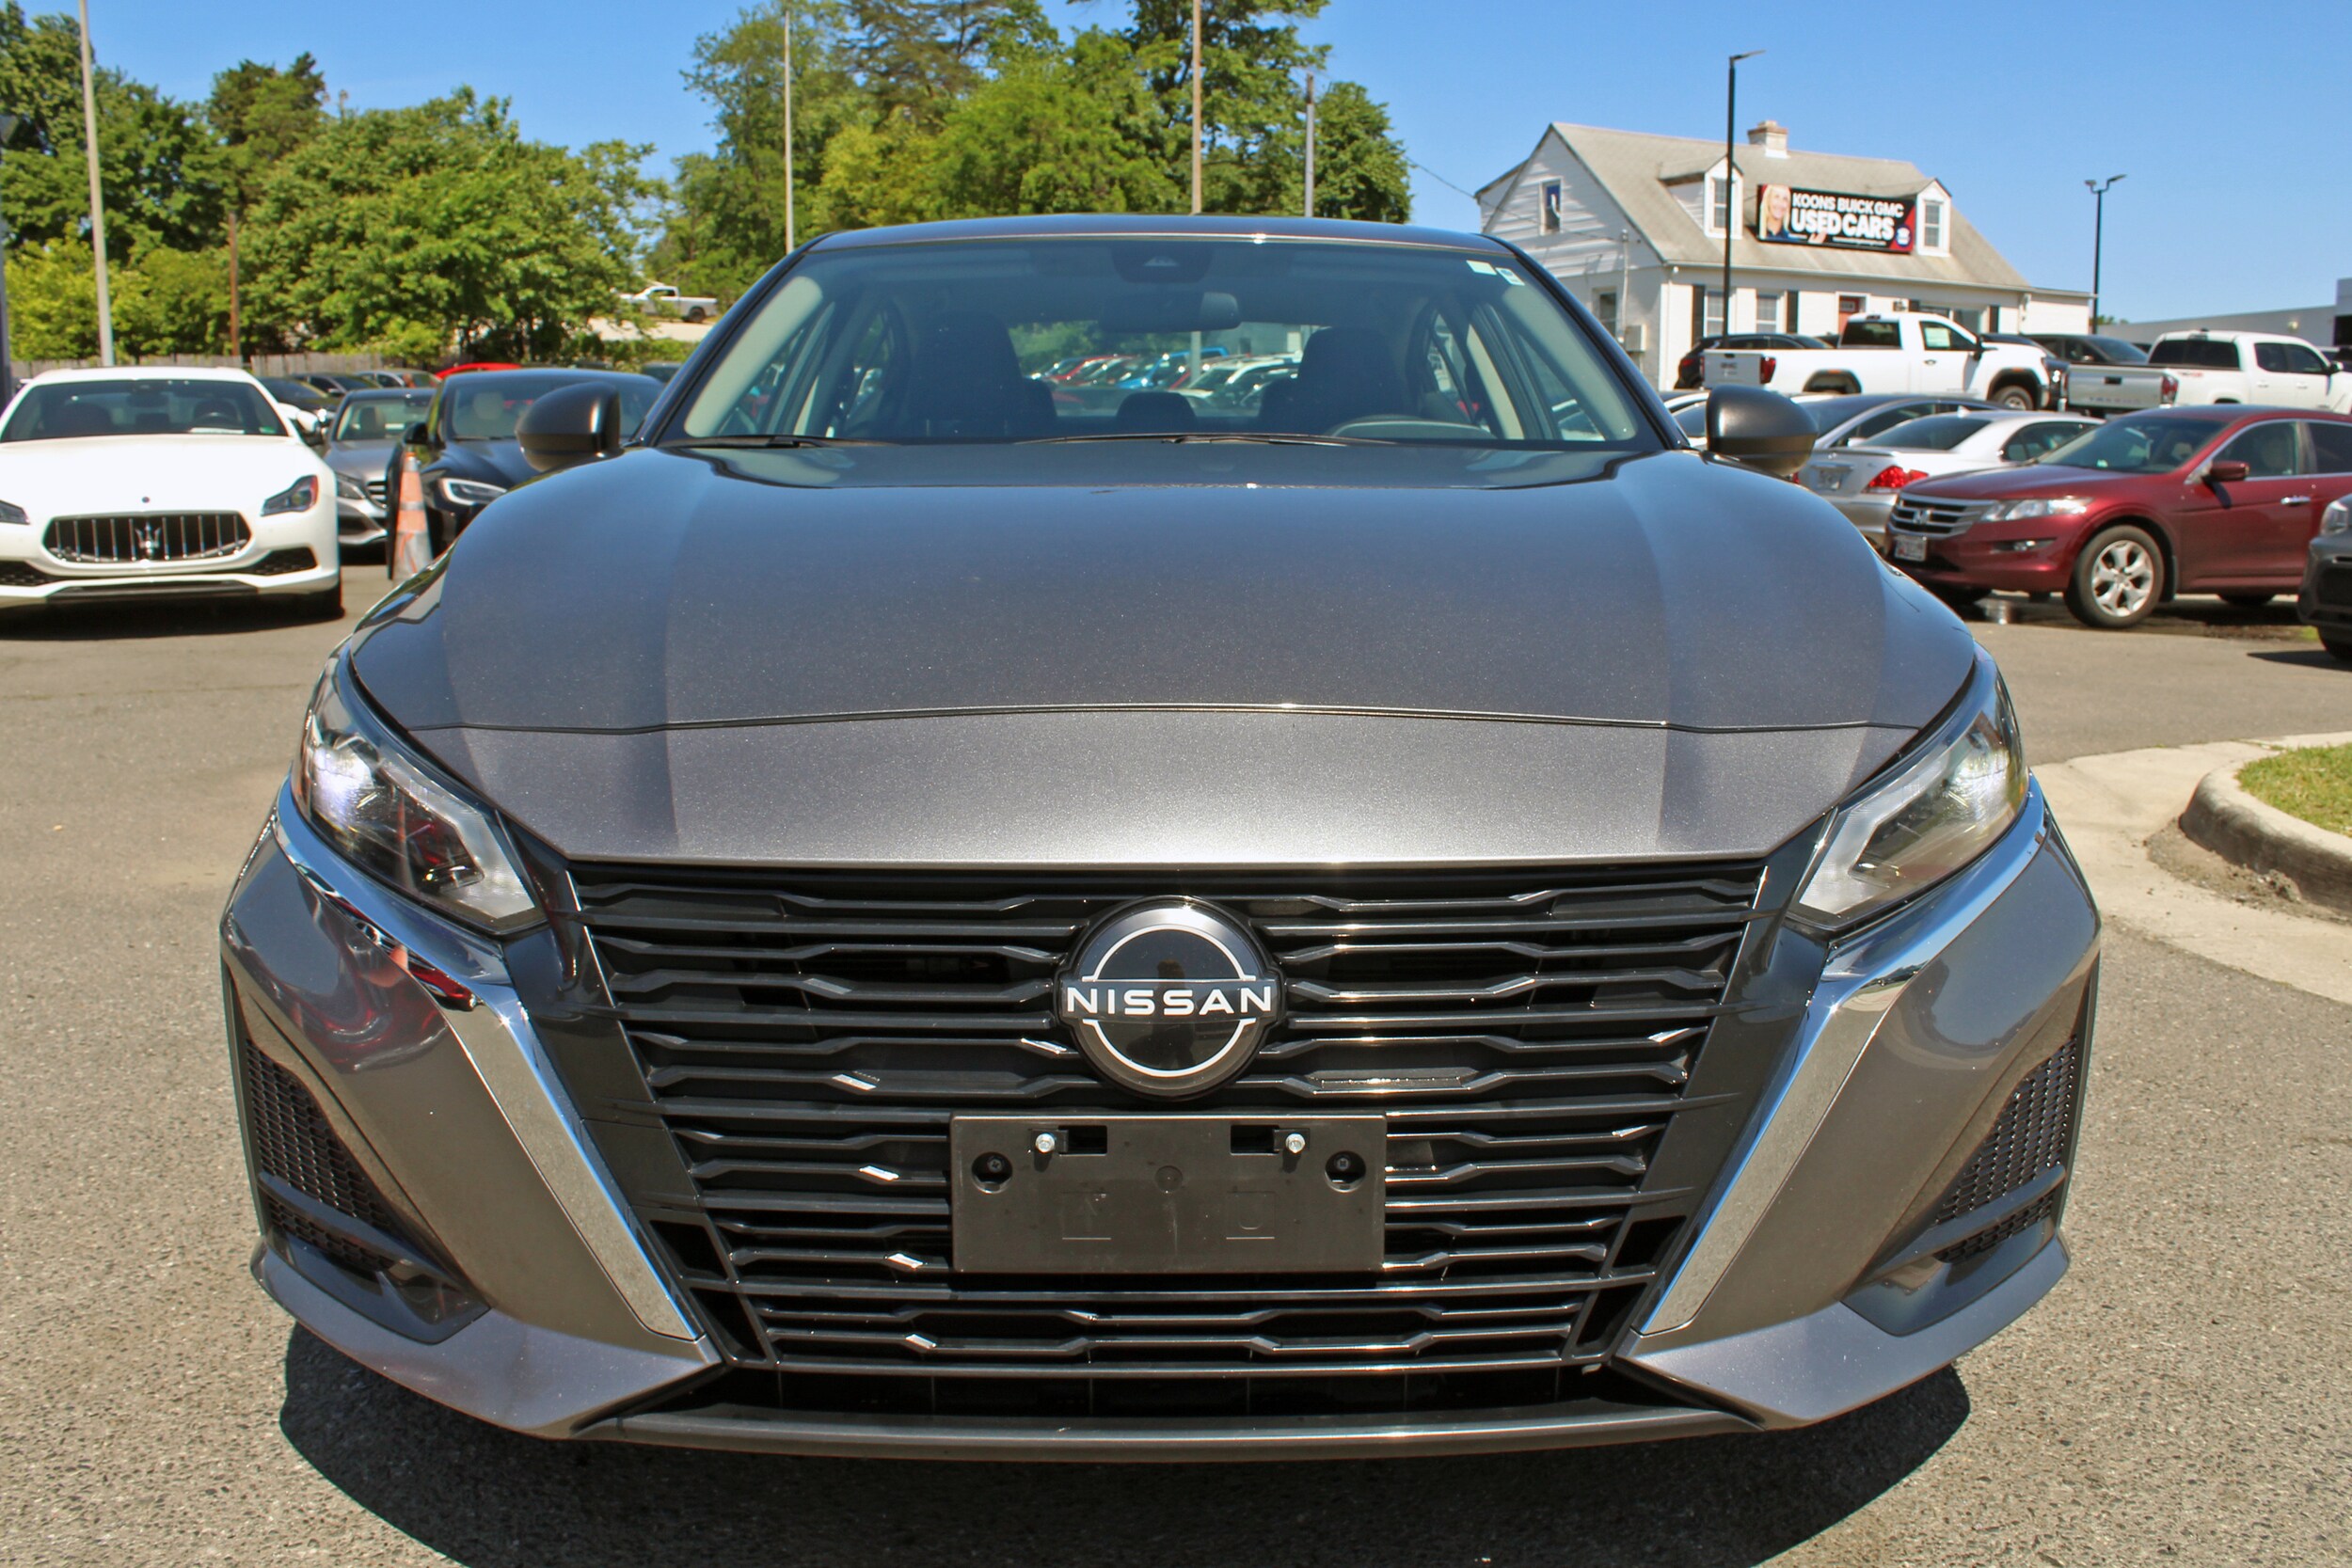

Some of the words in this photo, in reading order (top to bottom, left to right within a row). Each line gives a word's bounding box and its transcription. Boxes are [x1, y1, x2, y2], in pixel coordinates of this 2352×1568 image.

[1792, 193, 1836, 212] KOONS
[1837, 198, 1874, 214] BUICK
[1874, 201, 1904, 218] GMC
[1791, 208, 1842, 235] USED
[1842, 214, 1895, 241] CARS
[1067, 986, 1271, 1016] NISSAN
